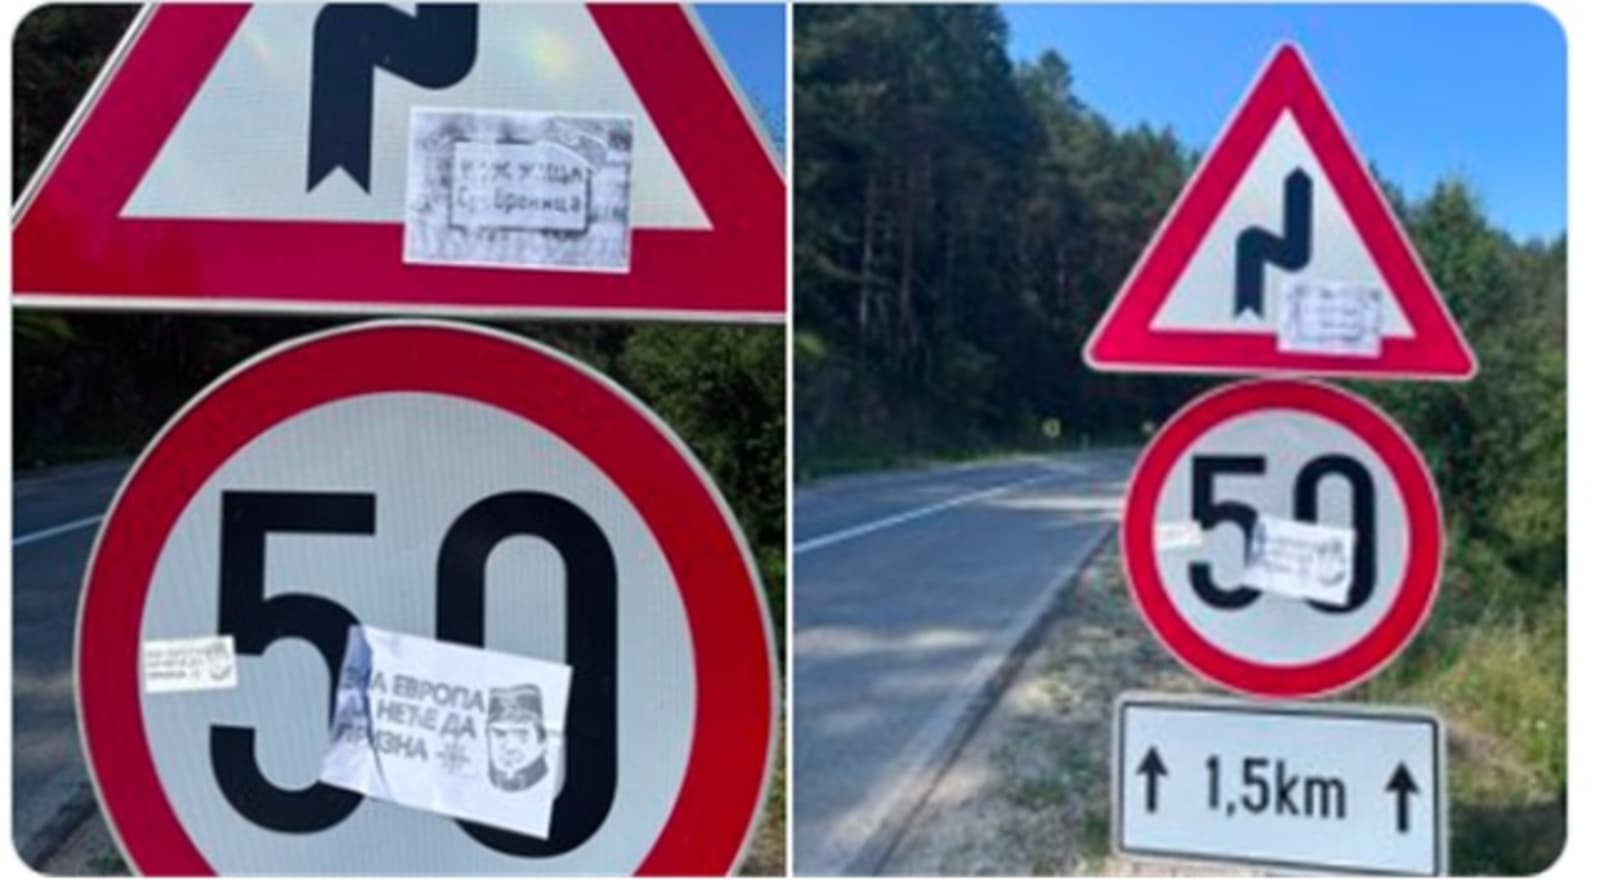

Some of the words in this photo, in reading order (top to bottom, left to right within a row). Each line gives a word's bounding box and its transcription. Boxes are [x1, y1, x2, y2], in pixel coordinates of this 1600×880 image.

[1188, 453, 1378, 616] 50
[209, 489, 619, 859] 50
[392, 673, 486, 714] ЕВРОПА
[440, 711, 477, 739] ДА
[1205, 755, 1347, 819] 1,5km
